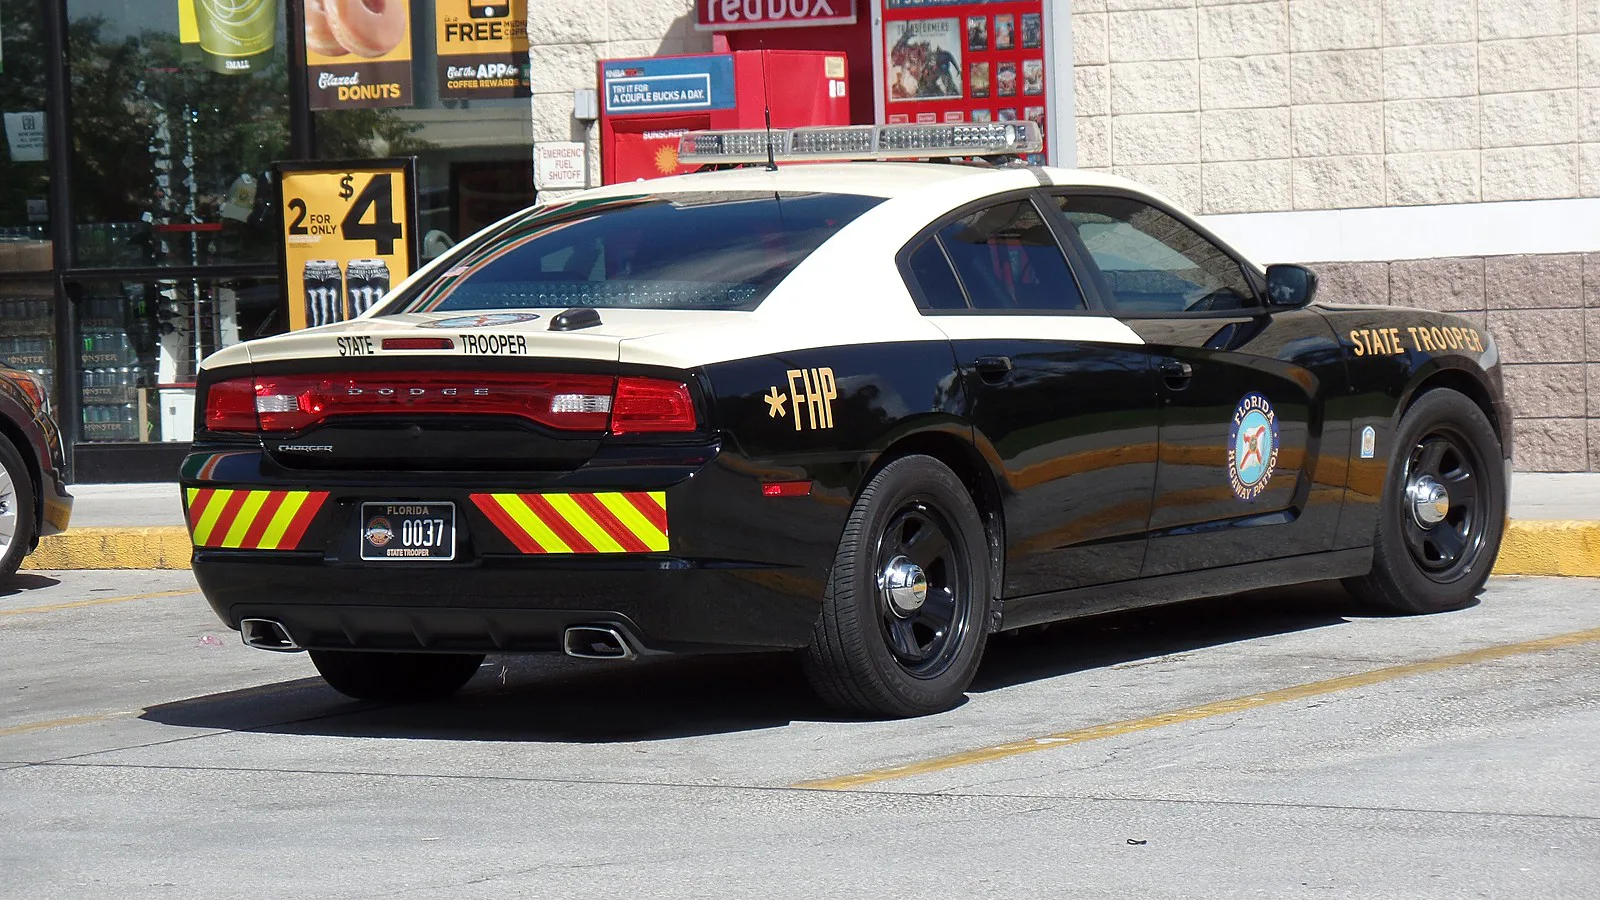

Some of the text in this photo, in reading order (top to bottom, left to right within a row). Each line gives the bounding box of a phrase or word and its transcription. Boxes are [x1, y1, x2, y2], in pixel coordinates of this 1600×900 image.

[504, 20, 527, 28] MEDIU
[445, 22, 502, 42] FREE
[225, 60, 250, 70] SMALL
[447, 66, 463, 79] Get
[463, 66, 476, 77] the
[477, 63, 506, 79] APP
[318, 71, 360, 89] Glazed
[447, 79, 519, 89] COFFEE REWARDS
[338, 83, 401, 101] DONUTS
[613, 84, 648, 93] TRY IT FOR
[613, 89, 704, 103] A COUPLE BUCKS A DAY.
[555, 160, 573, 169] FUEL
[549, 170, 581, 180] SHUTOFF
[287, 197, 309, 235] 2
[310, 214, 331, 224] FOR
[311, 225, 337, 235] ONLY
[337, 334, 527, 356] STATE TROOPER
[1350, 326, 1484, 356] STATE TROOPER
[8, 356, 45, 365] ONSTER
[82, 354, 117, 364] ONSTER
[348, 388, 489, 396] DODGE
[1235, 396, 1275, 426] FLORIDA
[84, 423, 122, 433] MONSTER
[278, 444, 333, 453] CHARGER
[1228, 448, 1279, 500] HIGHWAY PATROL
[387, 506, 430, 515] FLORIDA
[402, 519, 444, 547] 0037
[386, 549, 429, 557] STATE TROOPER
